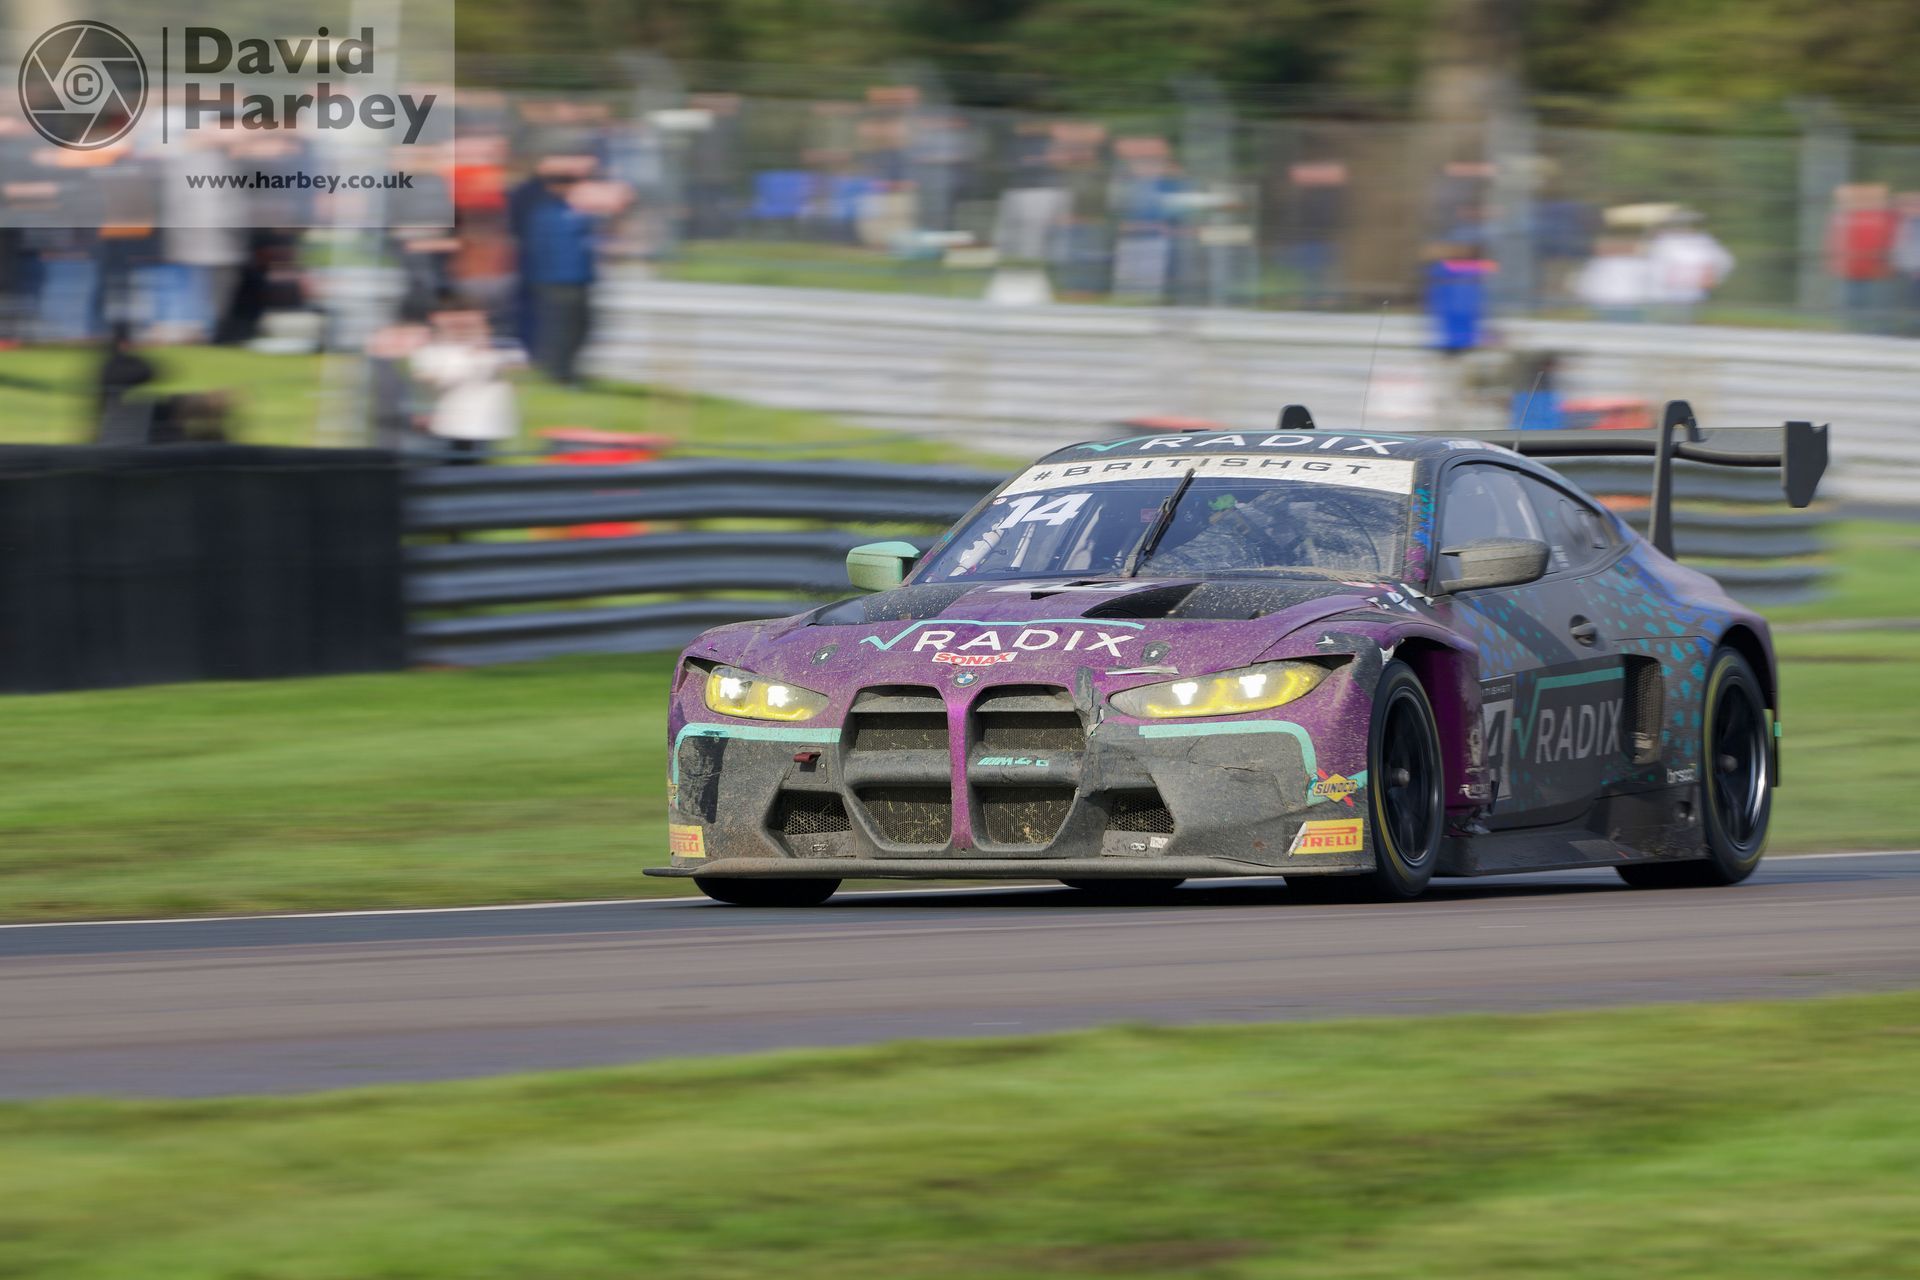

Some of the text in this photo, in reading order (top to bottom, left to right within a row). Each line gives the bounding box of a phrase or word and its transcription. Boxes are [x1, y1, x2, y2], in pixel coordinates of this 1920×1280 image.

[1139, 434, 1405, 455] RADIX
[1033, 457, 1371, 482] #BRITISHGT
[998, 492, 1094, 529] 14
[912, 629, 1135, 657] RADIX
[935, 652, 1010, 665] SONAX
[1535, 698, 1624, 764] RADIX
[1302, 835, 1357, 848] IRELLI
